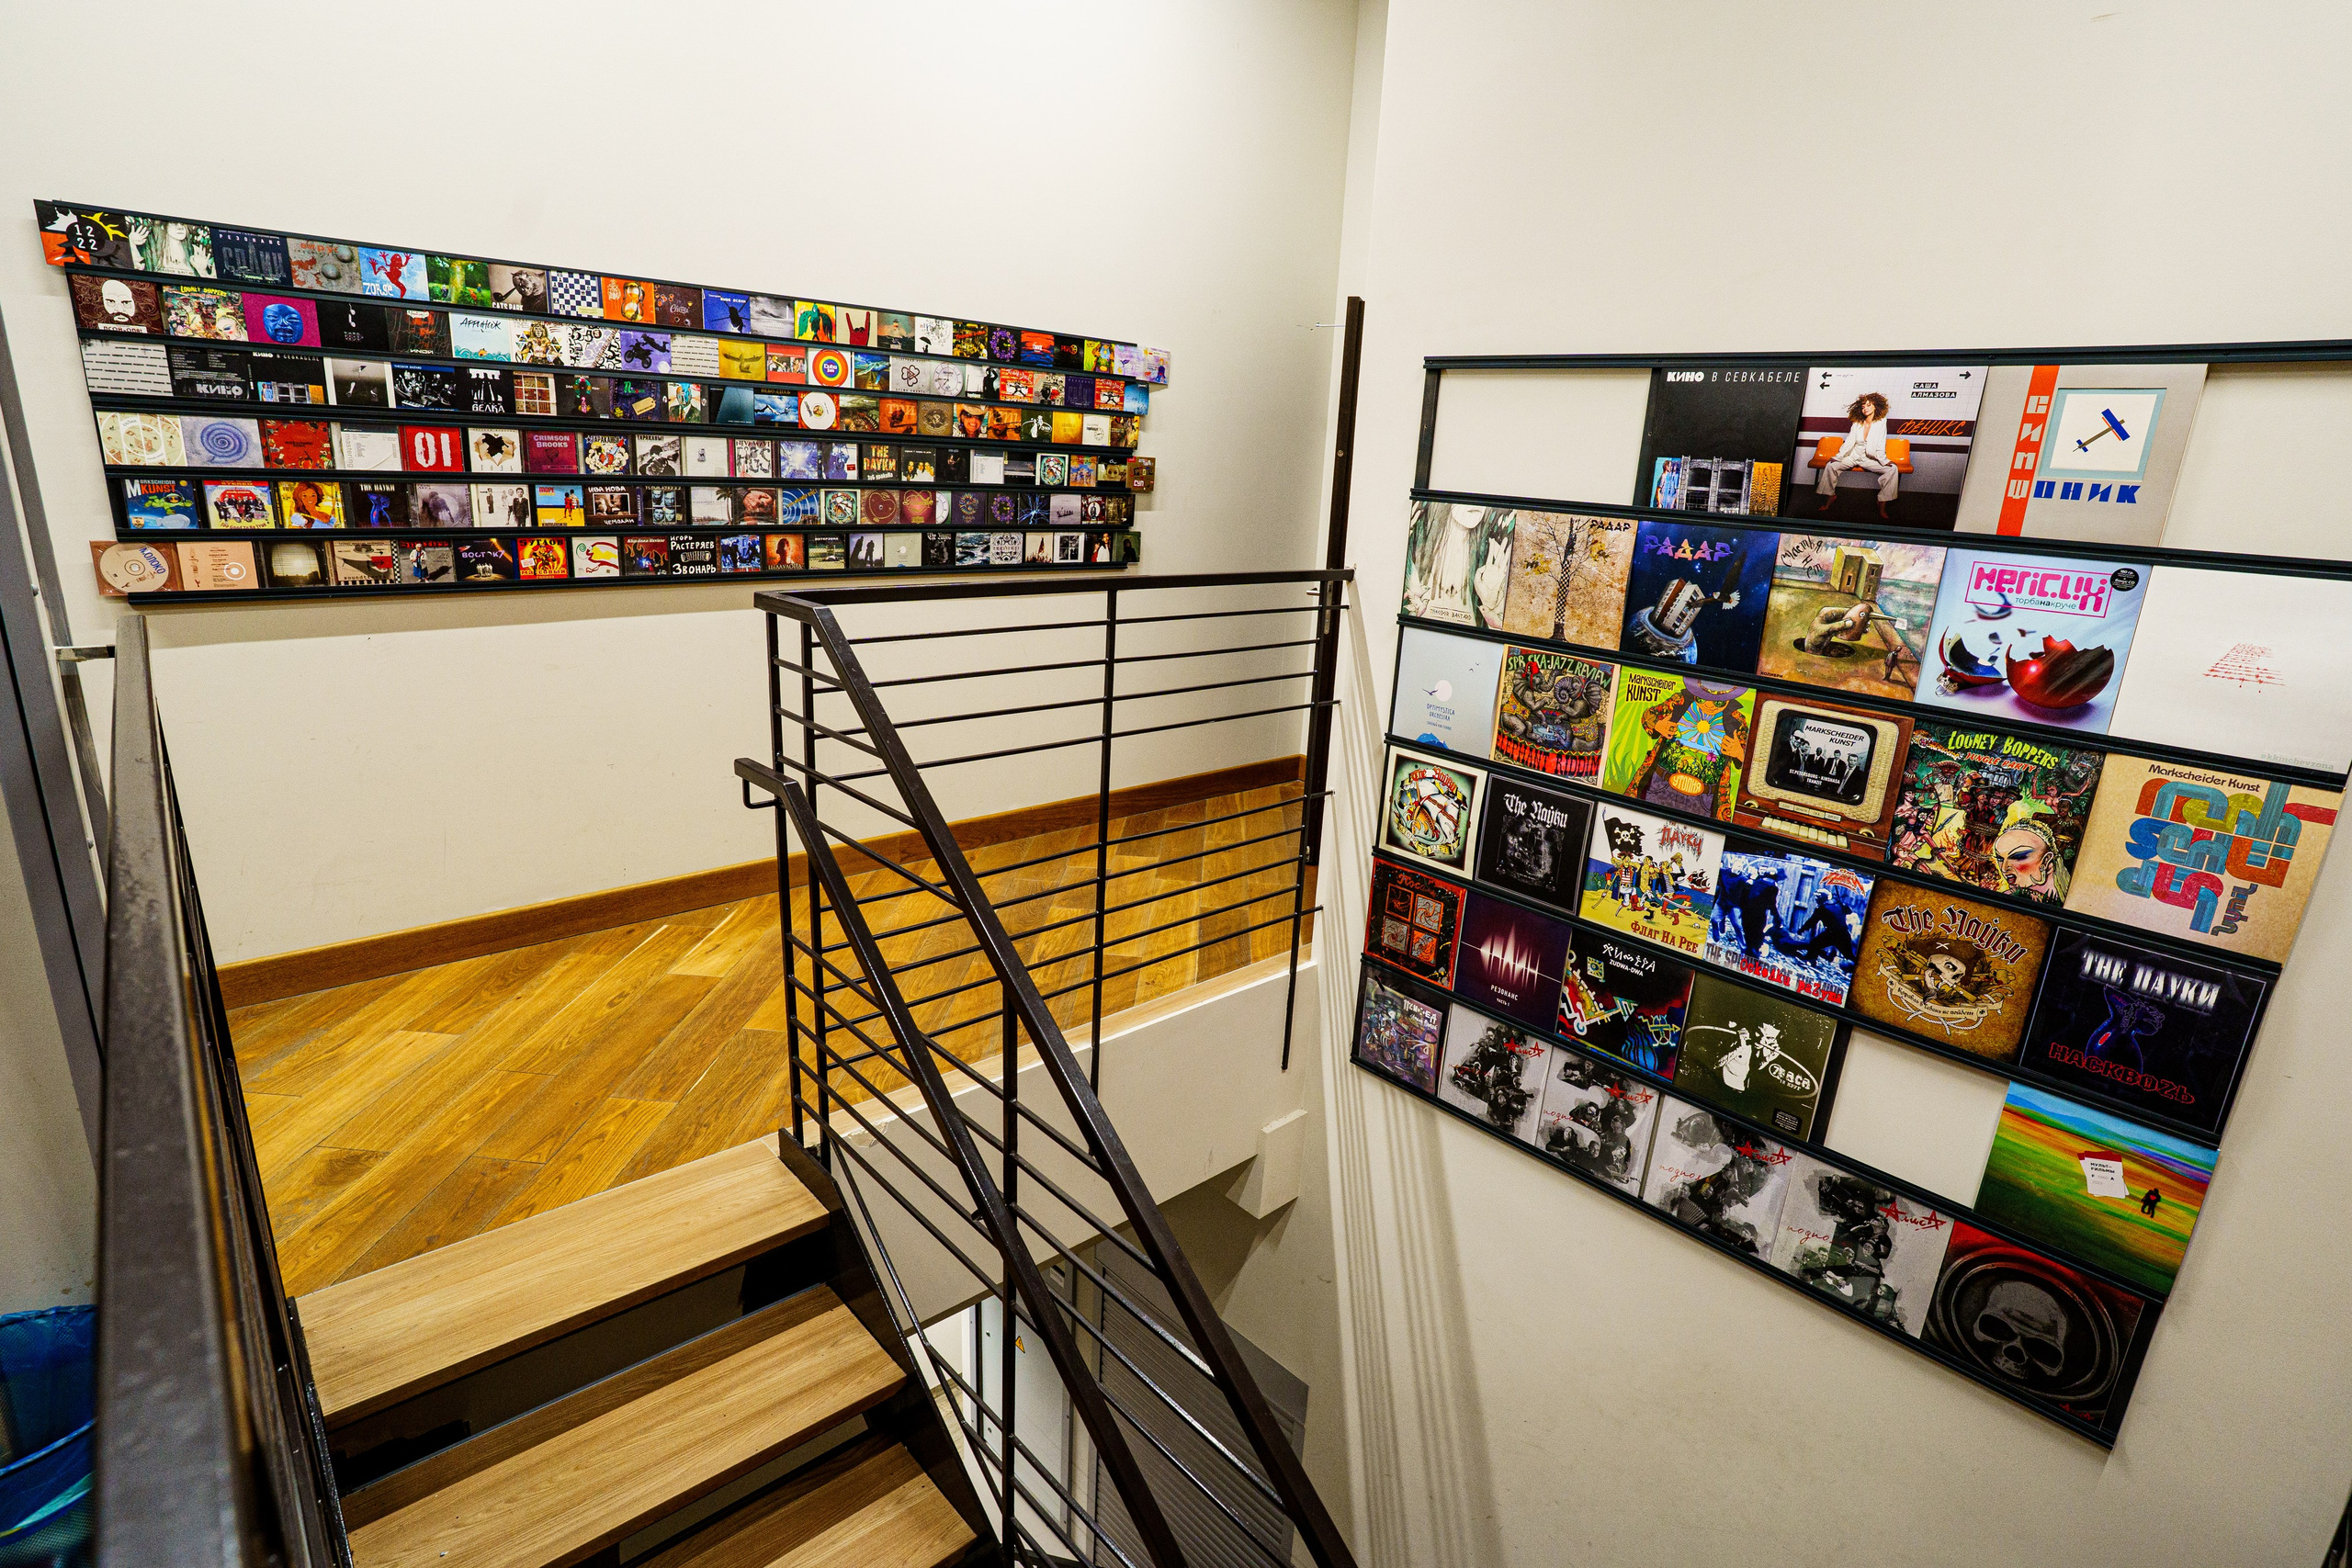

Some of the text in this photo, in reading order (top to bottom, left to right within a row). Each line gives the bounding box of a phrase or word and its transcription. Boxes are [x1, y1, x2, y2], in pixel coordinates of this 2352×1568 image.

[74, 224, 95, 237] 1 2
[77, 237, 97, 250] 2 2
[1667, 371, 1801, 384] КИНО В СЕВКАБЕЛЕ
[196, 383, 243, 396] КИНО
[1896, 419, 1967, 438] ФЕНИКС
[871, 446, 889, 458] THE
[141, 484, 176, 495] KUNST
[1589, 519, 1632, 533] РАДАР
[670, 541, 715, 550] РАСТЕРЯЕВ
[1643, 535, 1734, 562] РАДАР
[139, 547, 166, 575] МОЛОКО
[673, 563, 717, 575] ЗВОНАРЬ
[2015, 597, 2077, 610] торбанакруче
[1508, 653, 1612, 689] SPB SKA-JAZZ REVIEW
[1760, 671, 1783, 680] КОЛИБРИ
[1628, 672, 1677, 692] Markscheider
[1625, 683, 1663, 703] KUNST
[1804, 724, 1865, 742] MARKSCHEIDER
[1828, 736, 1857, 748] KUNST
[1948, 730, 1998, 751] LOONEY
[2003, 735, 2059, 770] BOPPERS
[1964, 751, 2037, 773] JUNGLE PARTY
[2260, 753, 2335, 771] @kkinchevzona
[1672, 775, 1702, 794] УТОПИЯ
[1820, 775, 1841, 786] KINSHASA
[2148, 763, 2261, 793] Markscheider Kunst
[1503, 793, 1527, 818] The
[1881, 904, 1935, 935] The
[1631, 919, 1699, 954] ФЛАГ НА РЕЕ
[1705, 942, 1723, 964] THE
[1609, 958, 1644, 977] ZUDWA-DWA
[2080, 949, 2128, 984] THE
[1490, 985, 1519, 1001] РЕЗОНАНС
[1497, 998, 1508, 1007] ЧАСТЬ
